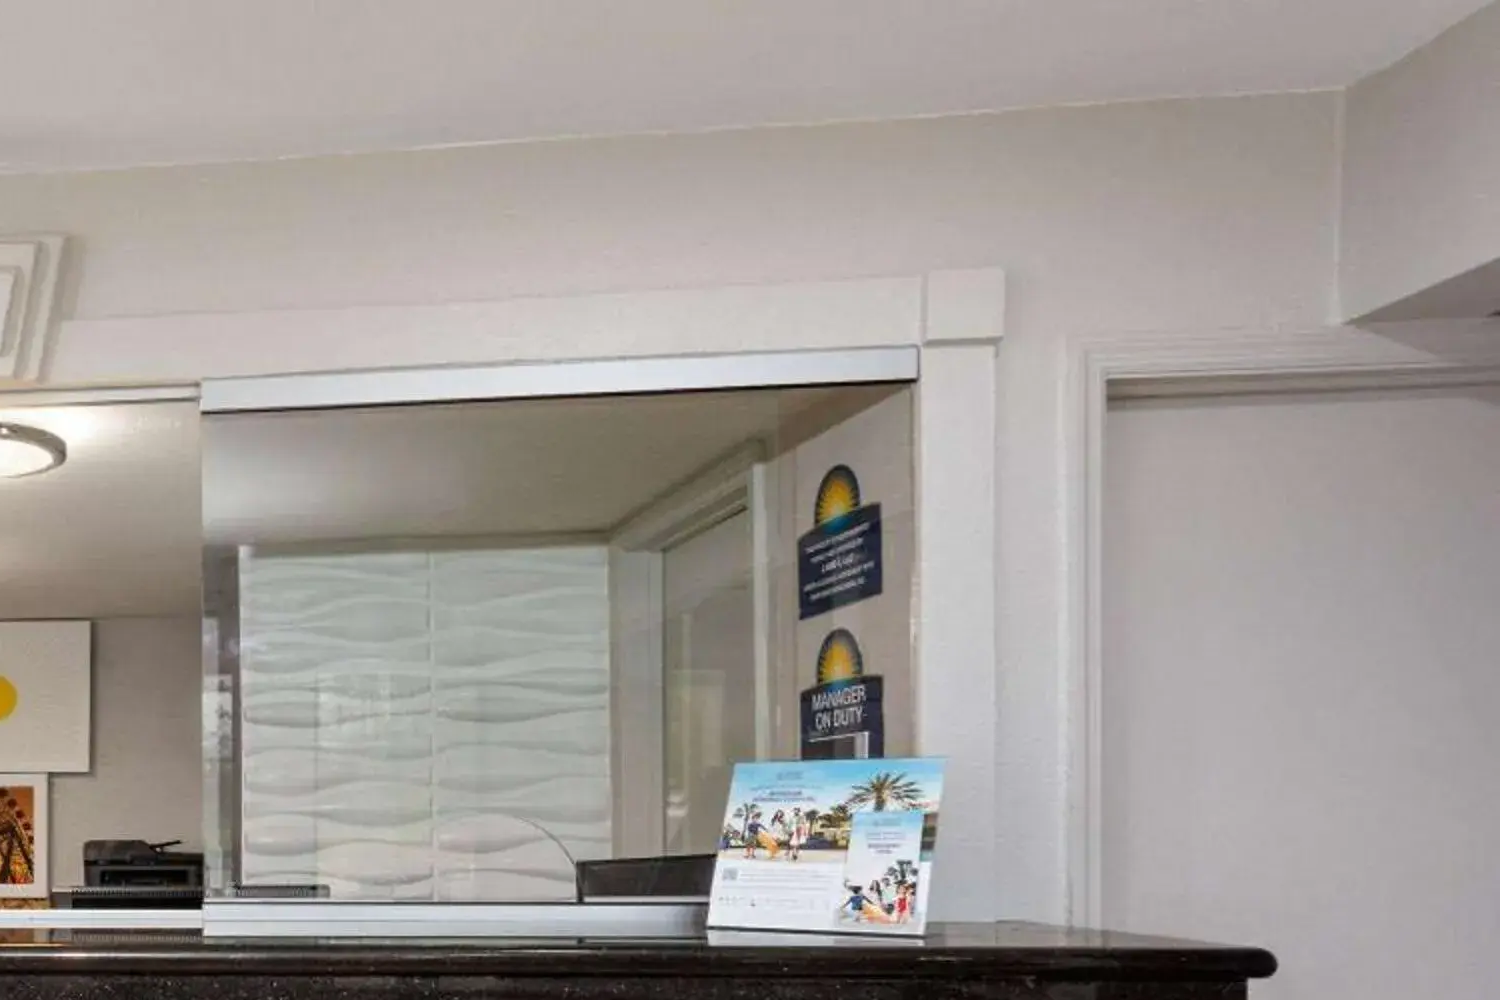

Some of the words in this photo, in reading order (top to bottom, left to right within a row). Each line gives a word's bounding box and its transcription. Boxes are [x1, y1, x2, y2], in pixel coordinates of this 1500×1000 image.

[811, 685, 867, 711] MANAGER
[815, 710, 831, 730] ON
[833, 705, 862, 727] DUTY
